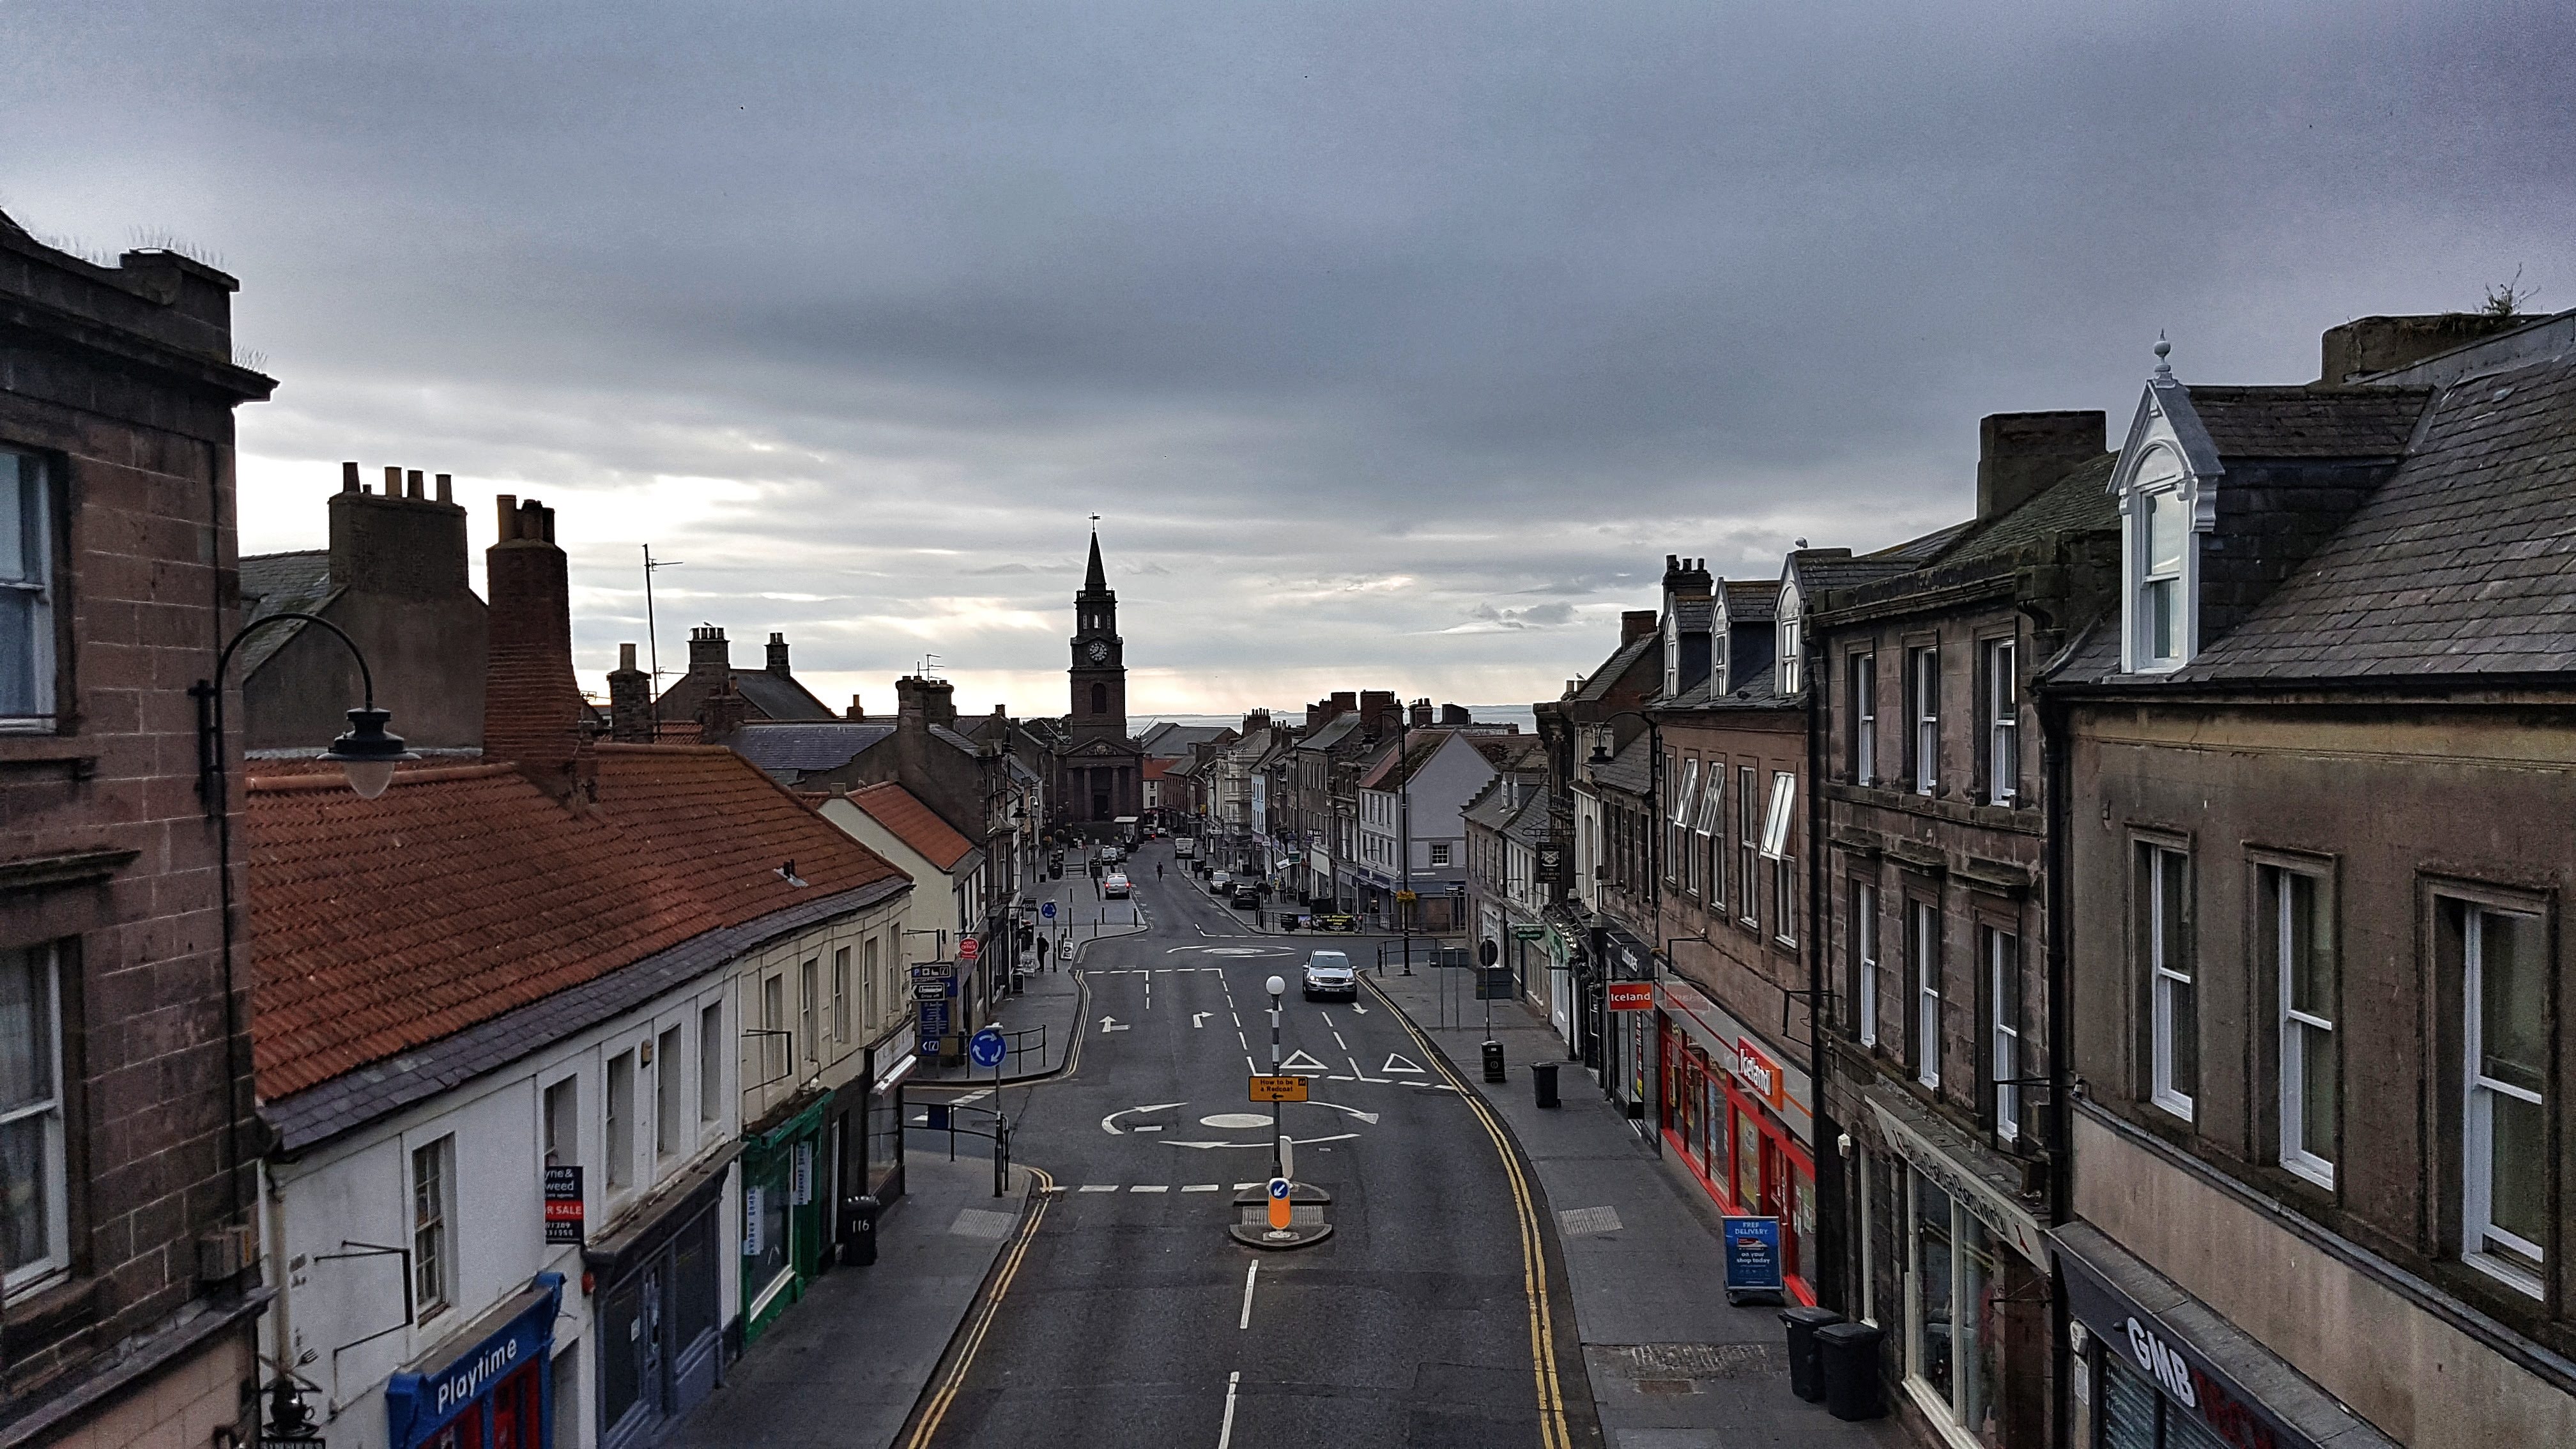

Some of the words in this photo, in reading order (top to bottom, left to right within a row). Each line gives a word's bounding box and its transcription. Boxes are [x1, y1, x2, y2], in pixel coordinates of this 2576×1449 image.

[1611, 992, 1651, 1002] Iceland
[1740, 1048, 1771, 1096] Iceland
[545, 1170, 564, 1181] yne
[564, 1169, 574, 1178] &
[546, 1180, 574, 1191] weed
[556, 1205, 582, 1215] SALE
[853, 1220, 870, 1233] 116
[2128, 1317, 2196, 1408] GMB
[438, 1338, 517, 1414] Playtime
